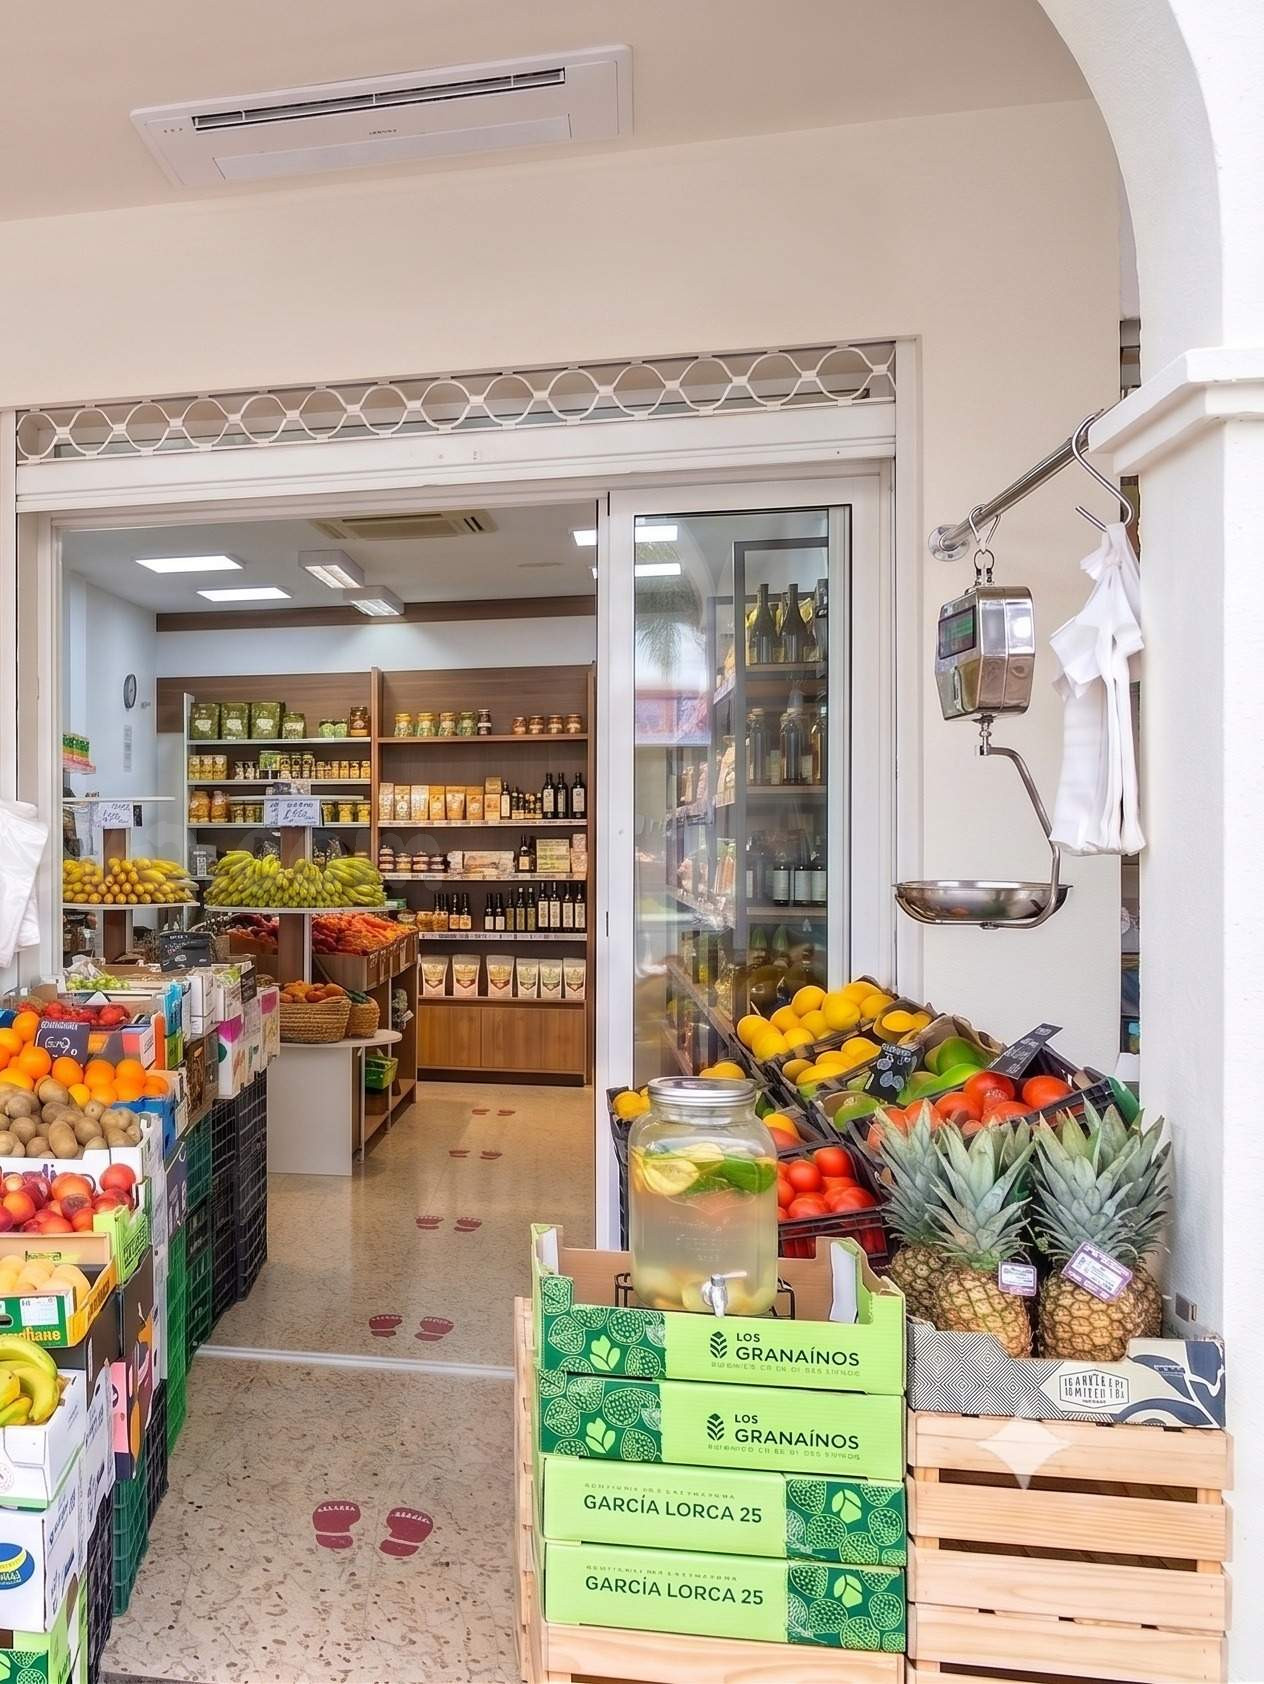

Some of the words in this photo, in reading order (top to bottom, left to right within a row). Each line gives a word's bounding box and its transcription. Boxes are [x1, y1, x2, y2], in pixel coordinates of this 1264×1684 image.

[736, 1332, 761, 1343] LOS
[735, 1346, 861, 1367] GRANAÍNOS
[734, 1414, 759, 1425] LOS
[734, 1429, 860, 1450] GRANAÍNOS
[583, 1494, 660, 1516] GARCÍA
[665, 1501, 735, 1522] LORCA
[739, 1507, 763, 1524] 25
[585, 1576, 662, 1597] GARCÍA
[667, 1583, 737, 1604] LORCA
[740, 1589, 764, 1606] 25
